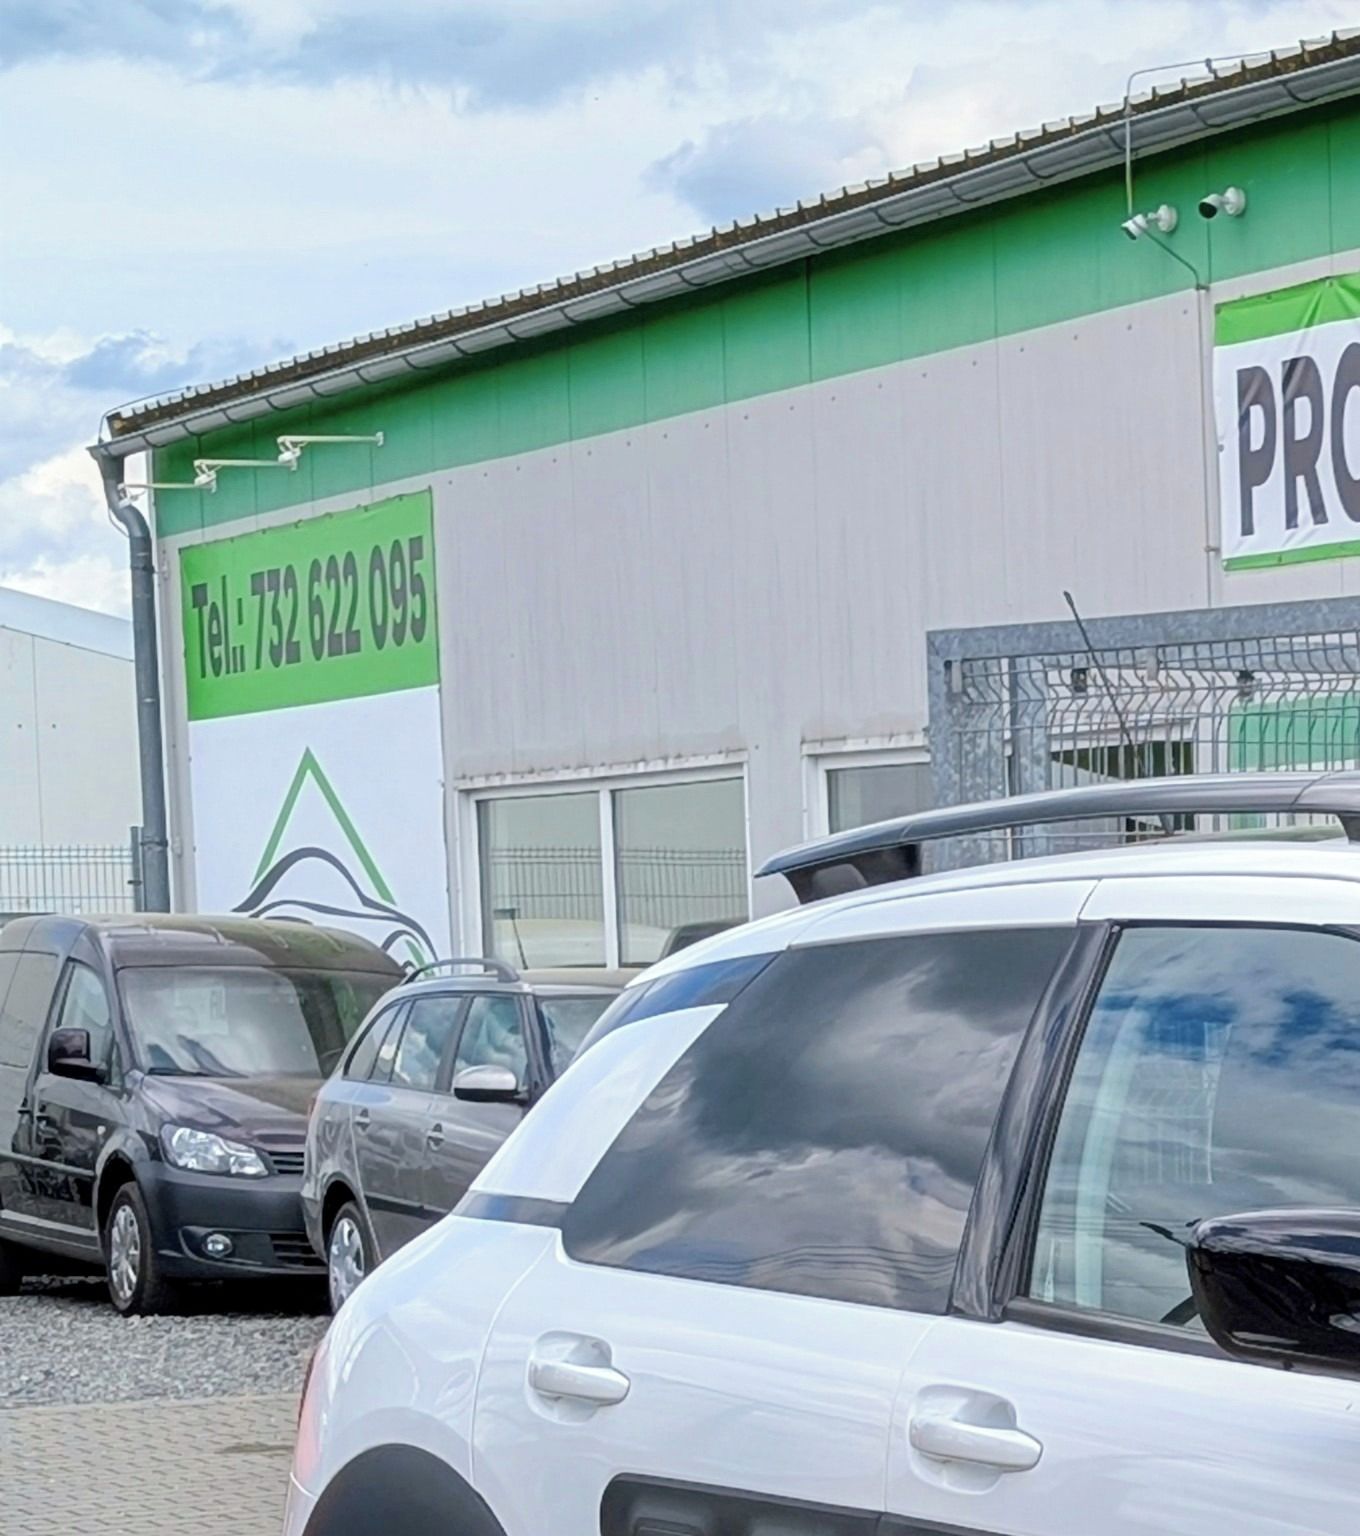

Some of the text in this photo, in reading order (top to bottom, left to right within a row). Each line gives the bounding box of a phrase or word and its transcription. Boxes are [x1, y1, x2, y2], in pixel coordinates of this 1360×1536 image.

[191, 535, 428, 679] Tel.: 732 622 095
